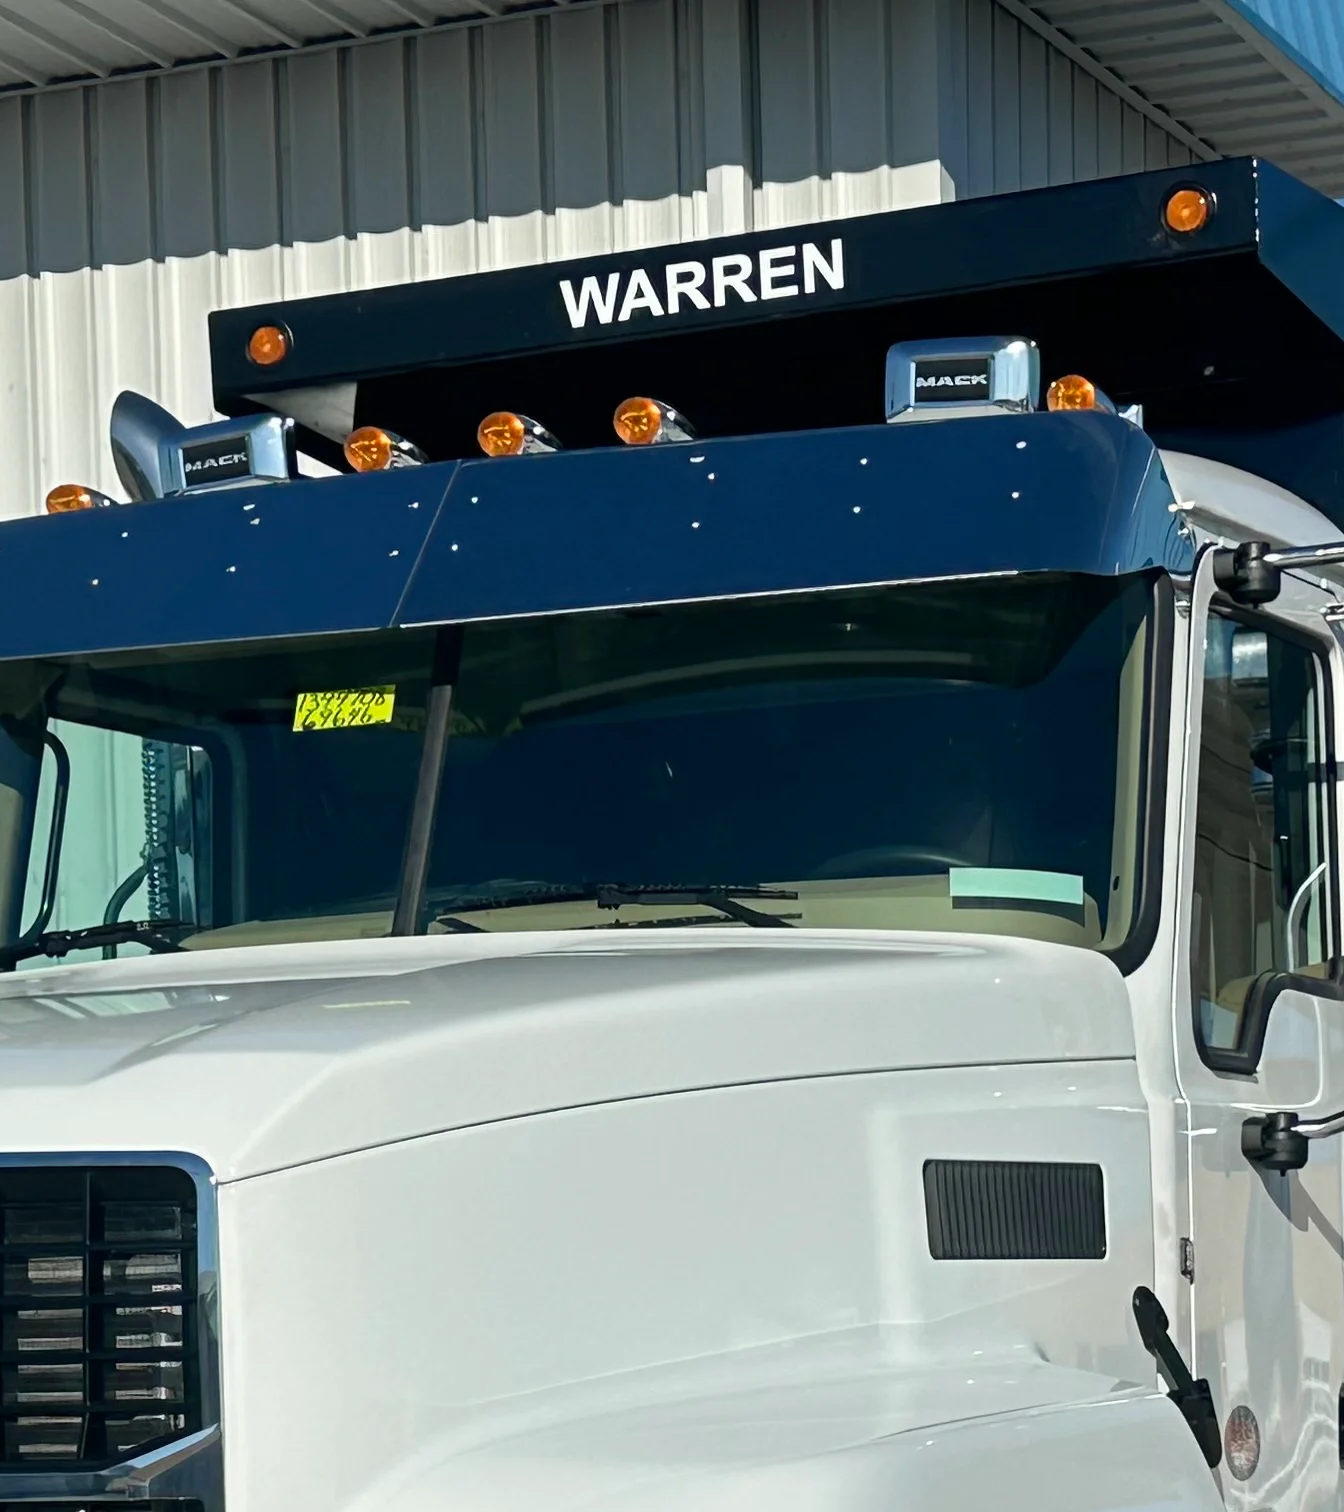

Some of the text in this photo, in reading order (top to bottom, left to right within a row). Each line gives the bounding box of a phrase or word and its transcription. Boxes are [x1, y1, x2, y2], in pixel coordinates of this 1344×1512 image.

[559, 238, 845, 328] WARREN
[916, 374, 988, 387] MACK
[184, 452, 248, 472] MACK
